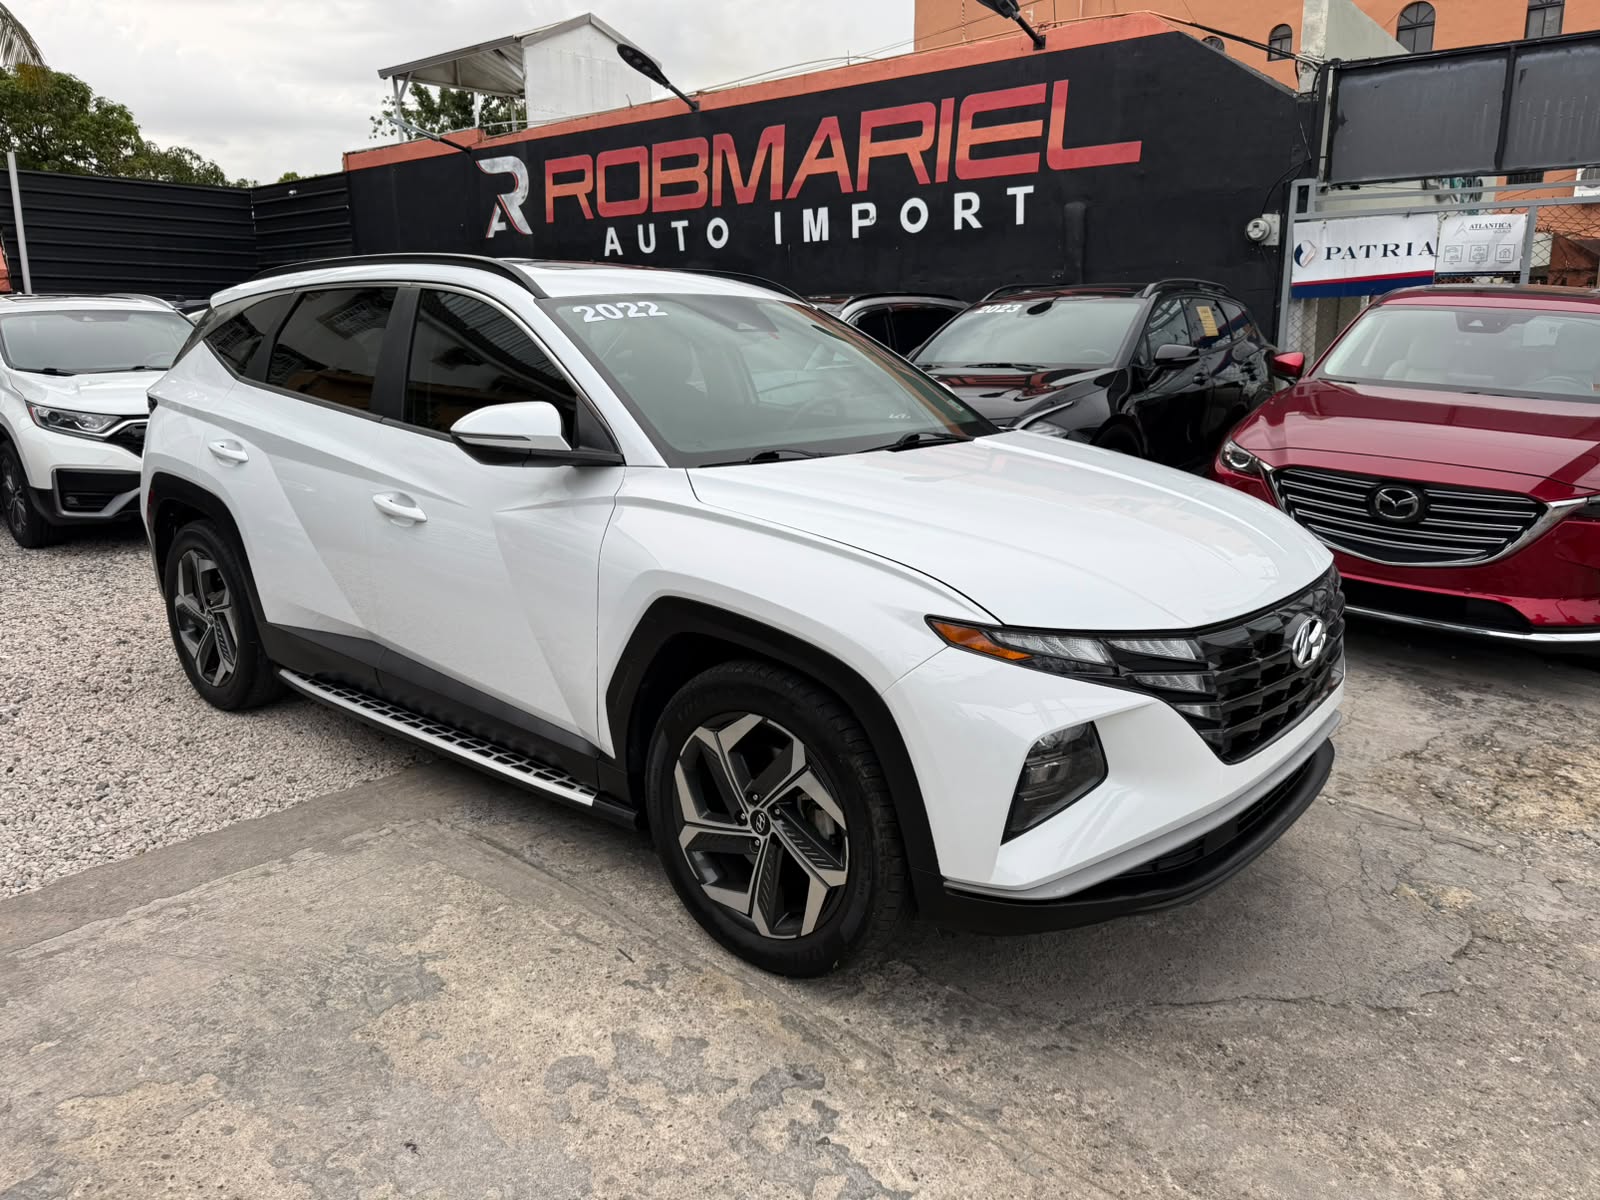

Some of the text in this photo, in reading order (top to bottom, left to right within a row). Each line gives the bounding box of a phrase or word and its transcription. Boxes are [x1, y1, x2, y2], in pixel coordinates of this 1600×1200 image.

[545, 79, 1142, 224] ROBMARIEL
[604, 185, 1035, 257] AUTO IMPORT
[1324, 241, 1435, 260] PATRIA
[572, 301, 668, 323] 2022
[974, 304, 1023, 314] 2023
